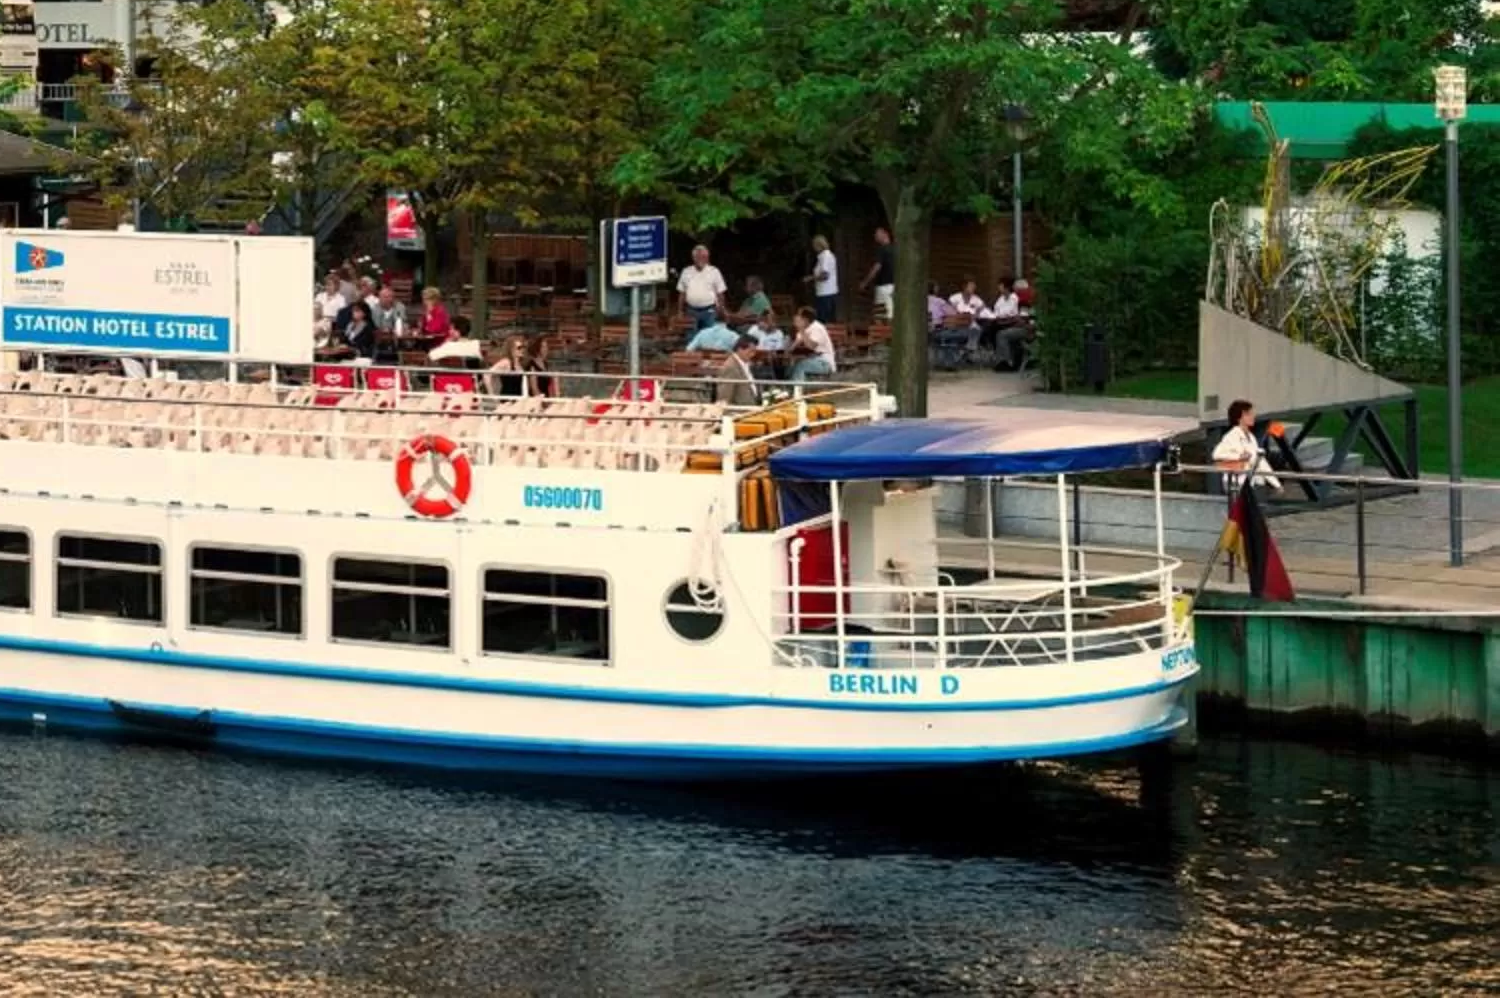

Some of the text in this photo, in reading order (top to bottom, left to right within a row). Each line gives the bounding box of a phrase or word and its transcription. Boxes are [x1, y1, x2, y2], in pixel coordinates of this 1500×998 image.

[154, 269, 212, 287] ESTREL
[14, 314, 219, 341] STATION HOTEL ESTREL
[828, 673, 959, 695] BERLIN D
